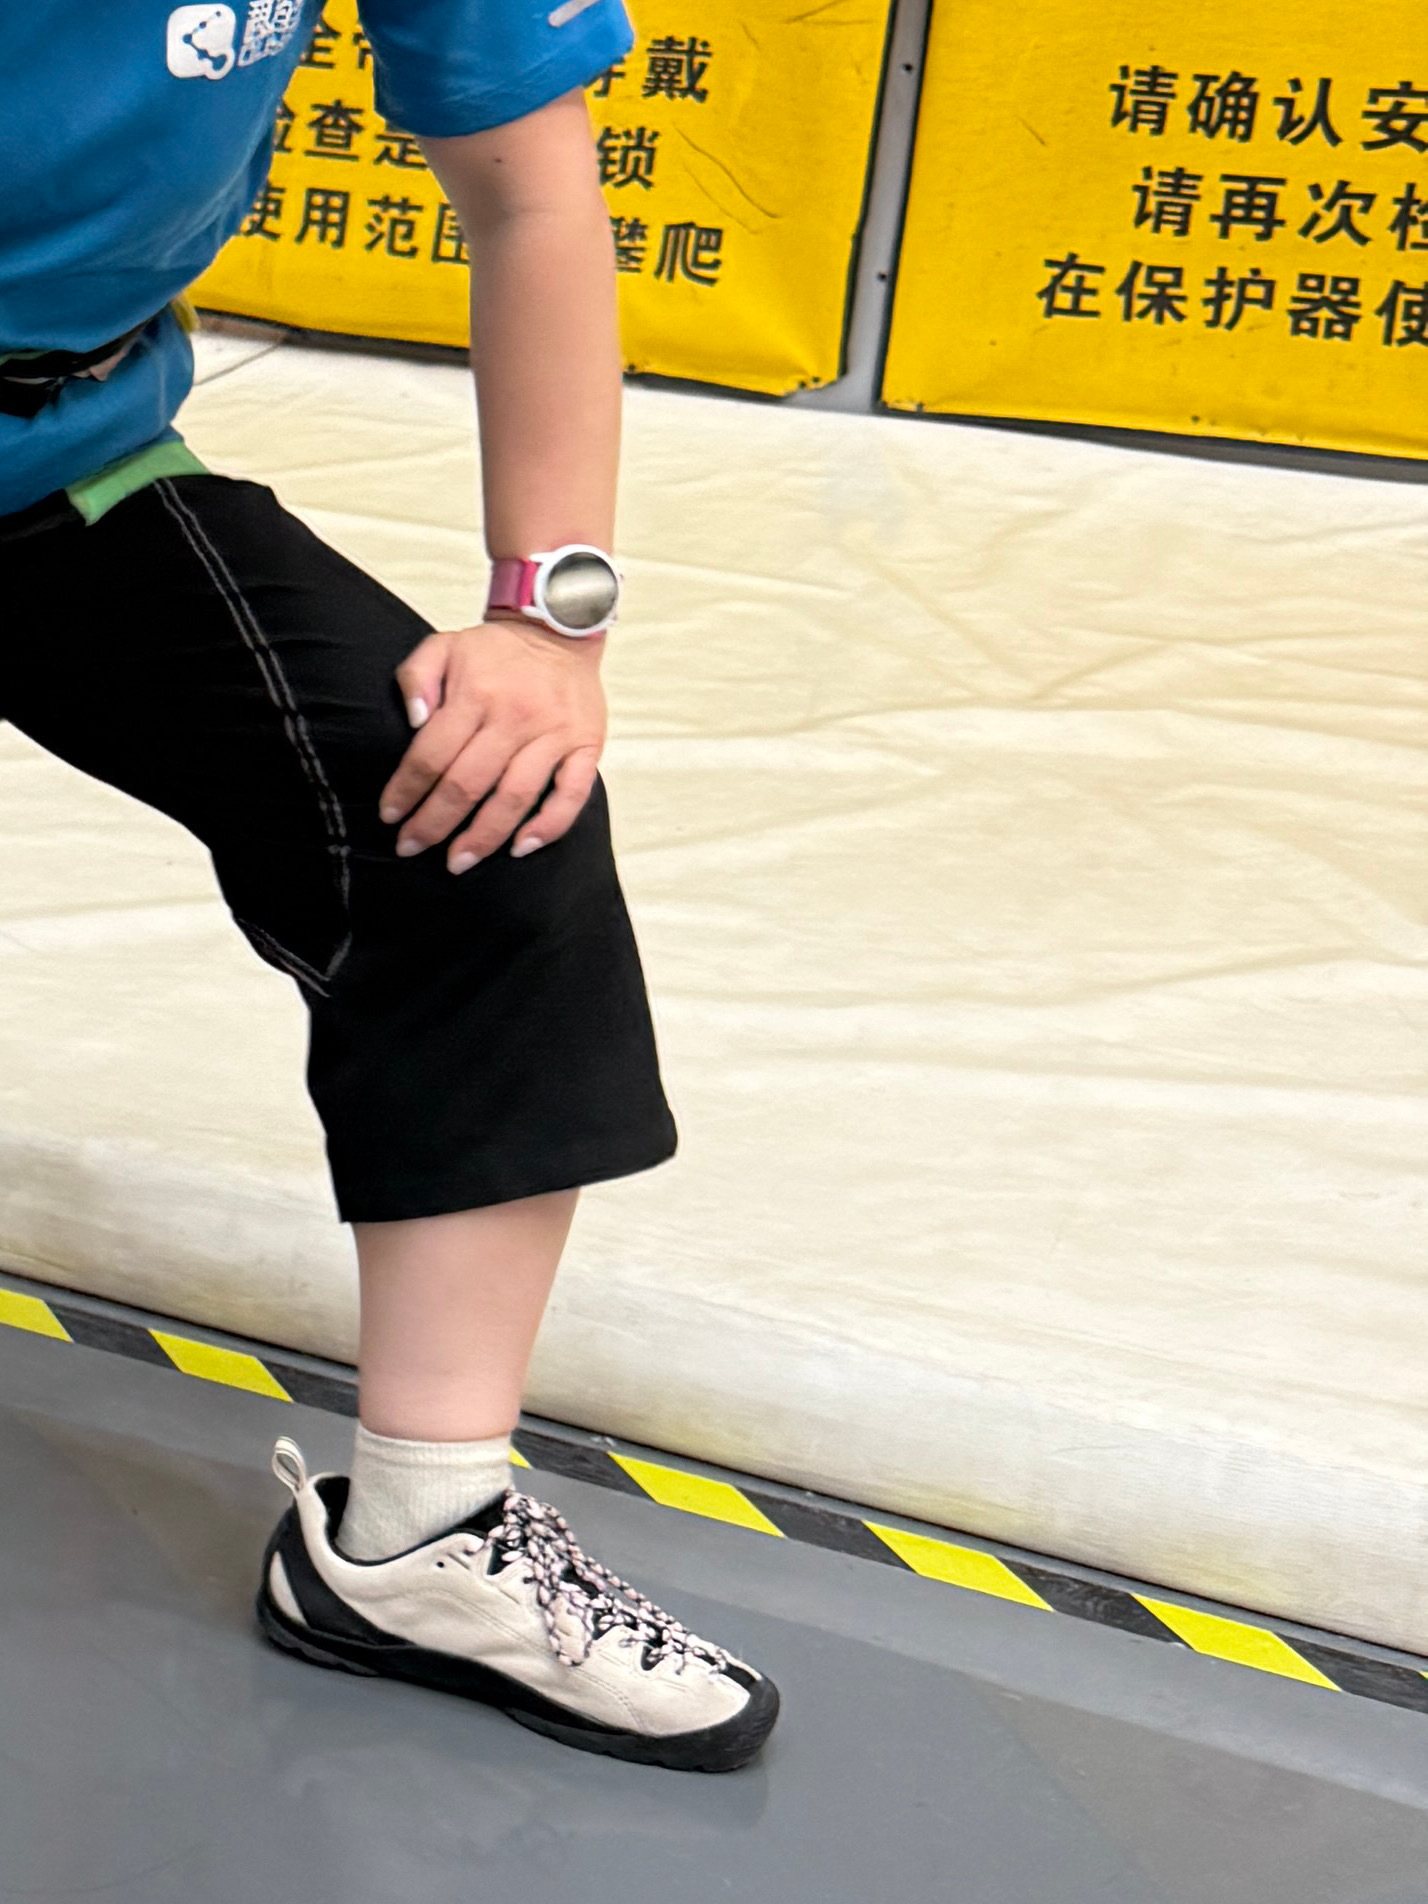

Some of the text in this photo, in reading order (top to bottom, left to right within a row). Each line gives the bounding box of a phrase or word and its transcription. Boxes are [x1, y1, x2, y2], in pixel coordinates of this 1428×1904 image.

[1110, 66, 1428, 152] 请确认安
[1037, 253, 1428, 346] 在保护器使
